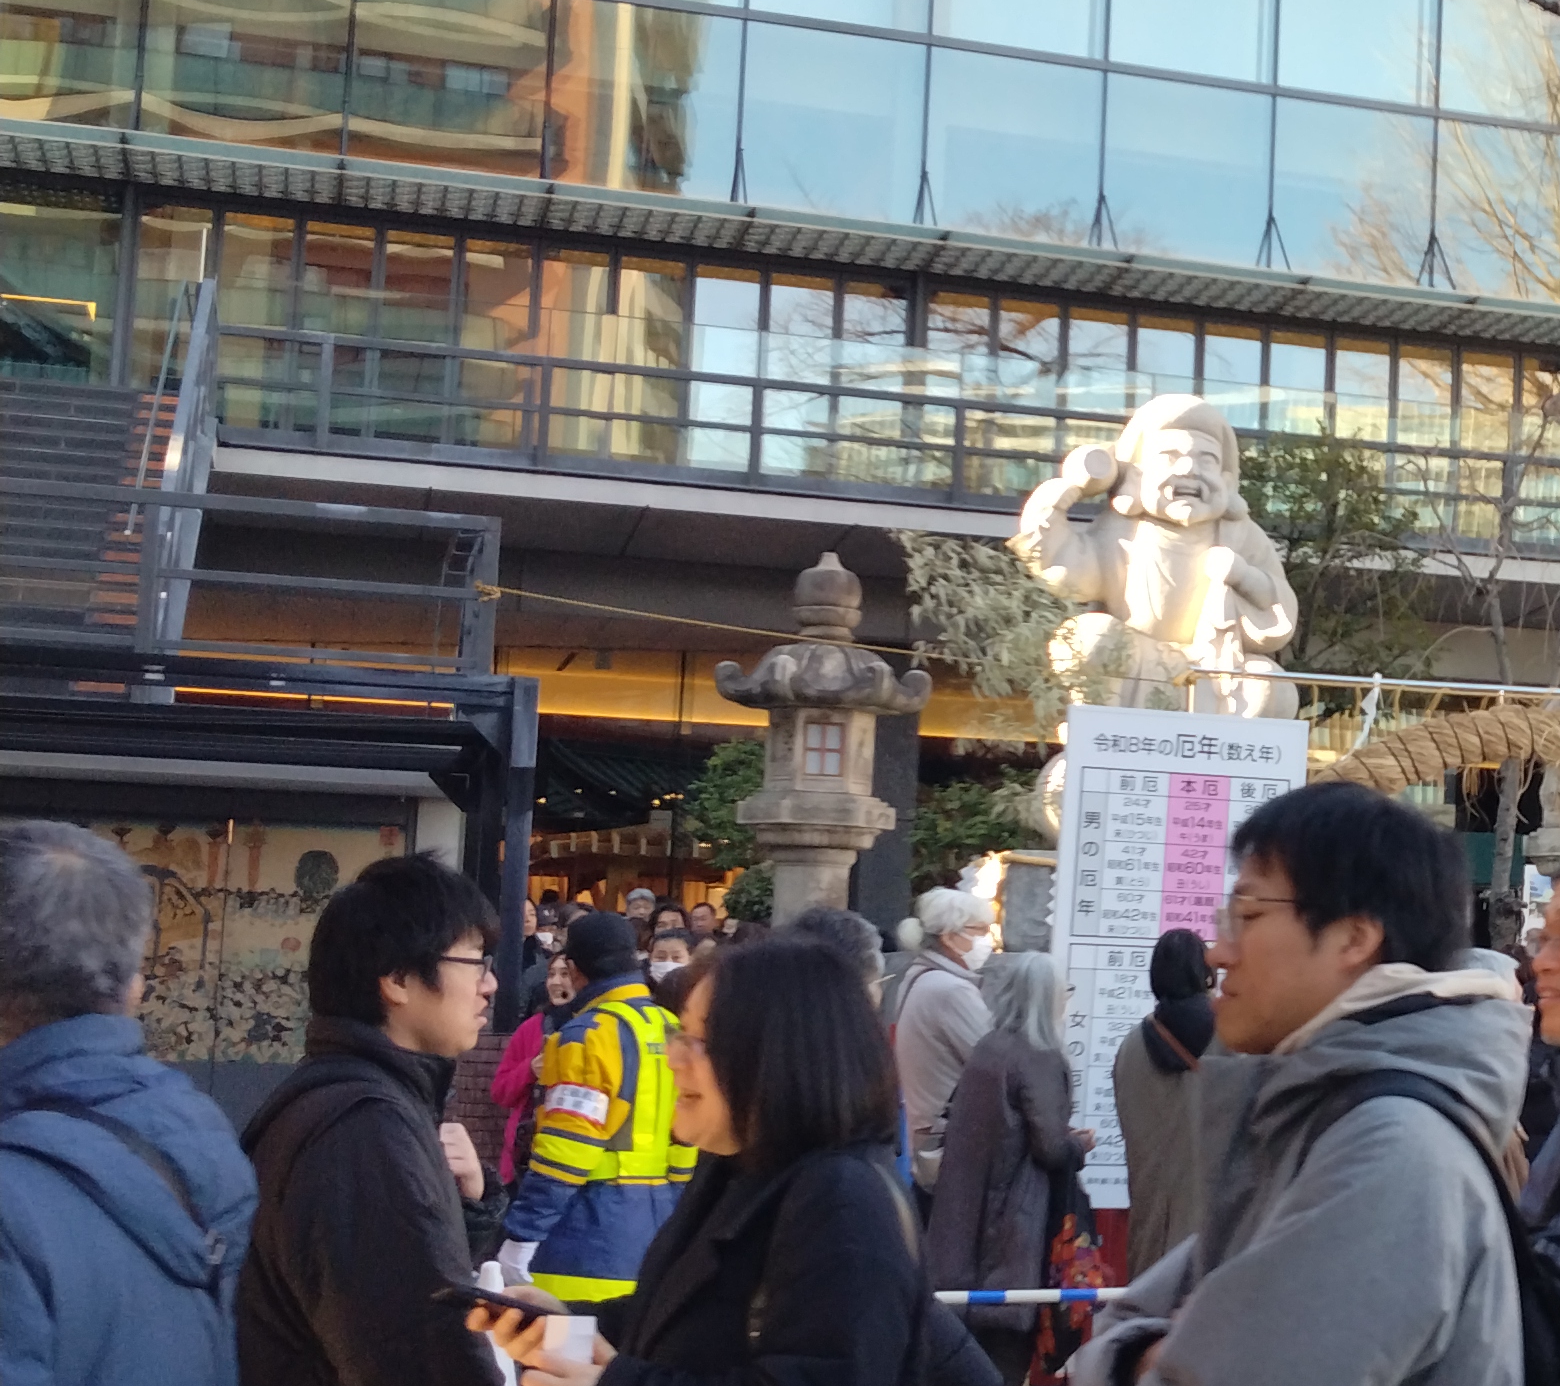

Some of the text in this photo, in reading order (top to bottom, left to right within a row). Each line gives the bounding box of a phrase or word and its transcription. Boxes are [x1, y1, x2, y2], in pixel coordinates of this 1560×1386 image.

[1093, 732, 1282, 765] 令和8年の厄年(数え年)
[1180, 779, 1219, 796] 本厄
[1077, 811, 1101, 917] 男の厄年
[1181, 849, 1209, 860] 42才
